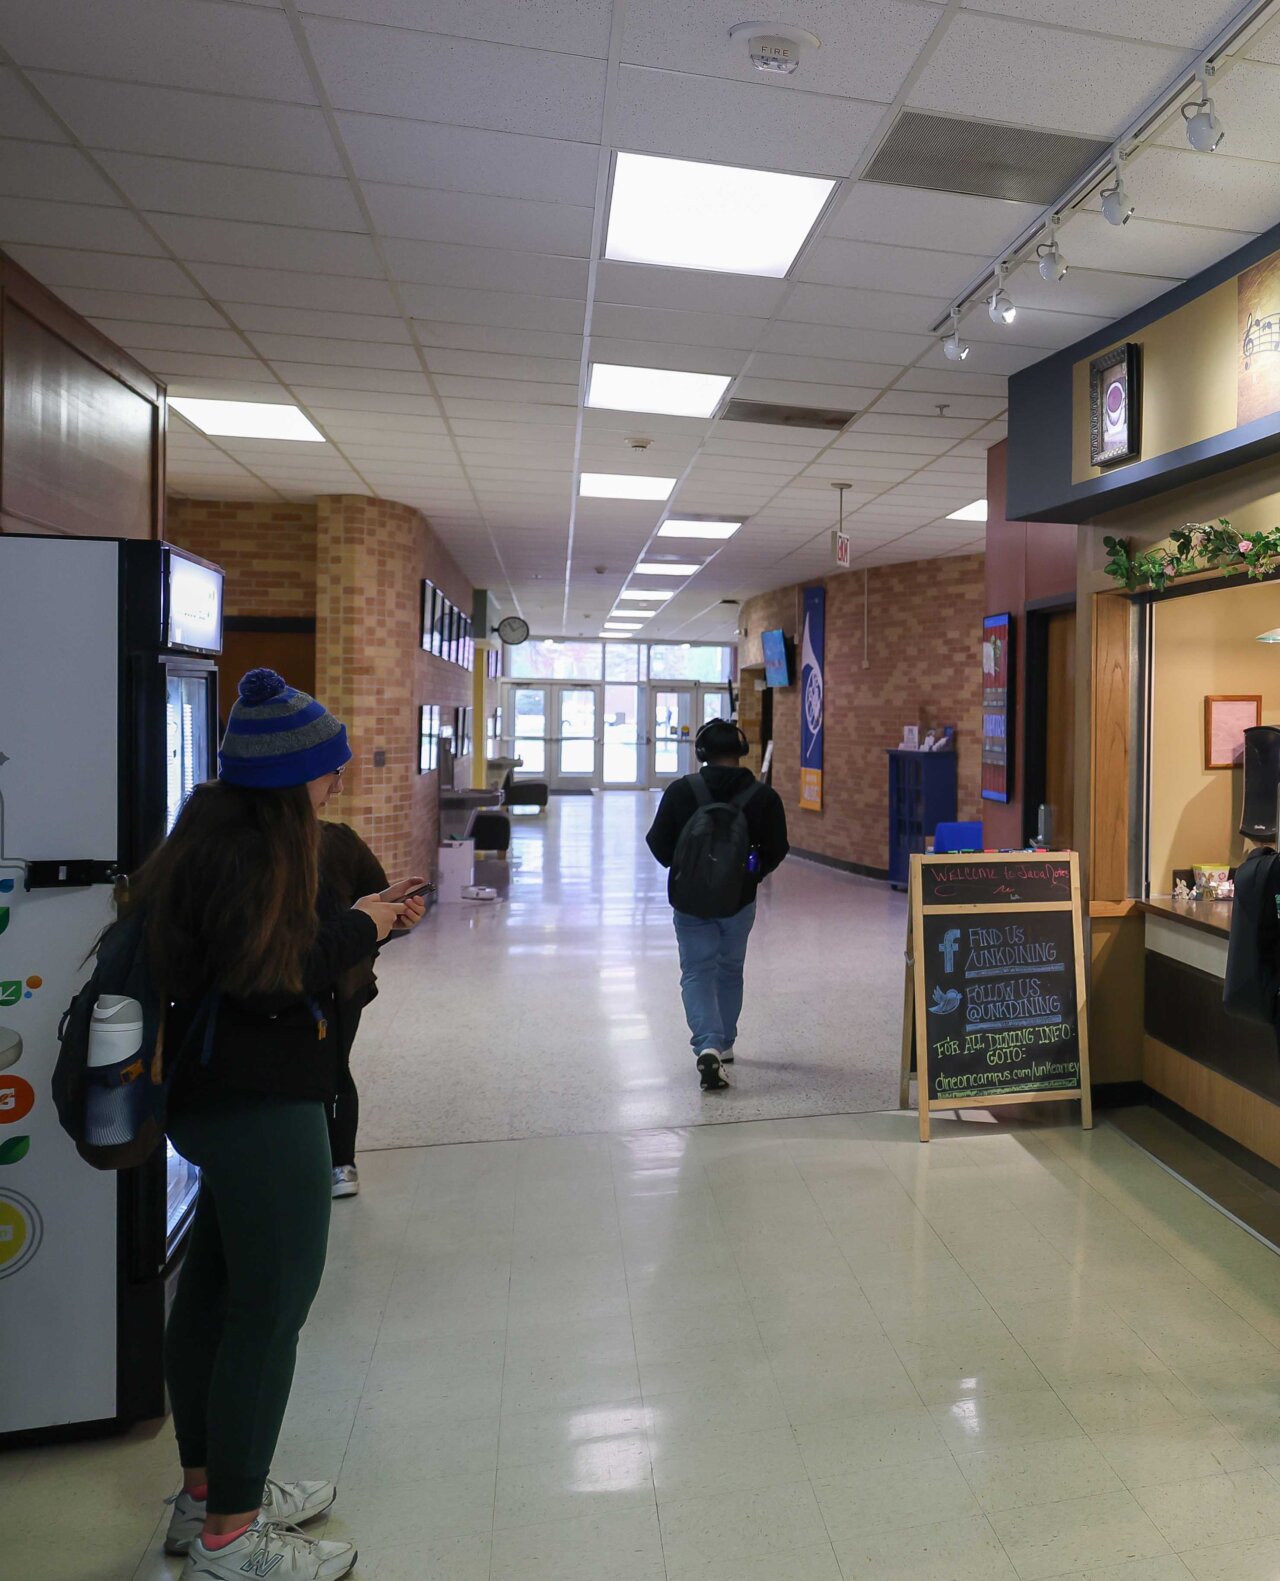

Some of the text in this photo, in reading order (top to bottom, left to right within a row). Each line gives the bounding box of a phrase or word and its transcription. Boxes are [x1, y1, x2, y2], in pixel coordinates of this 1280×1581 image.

[761, 46, 789, 57] FIRE
[931, 866, 999, 882] WELCOME
[1003, 865, 1015, 879] to
[968, 926, 1003, 947] FIND
[965, 942, 1057, 969] /UNKDINING
[966, 982, 1017, 1006] FOLLOW
[966, 996, 1061, 1022] @UNKDINING
[933, 1038, 960, 1058] FOR
[964, 1033, 985, 1053] ALL
[986, 1027, 1034, 1050] DINING
